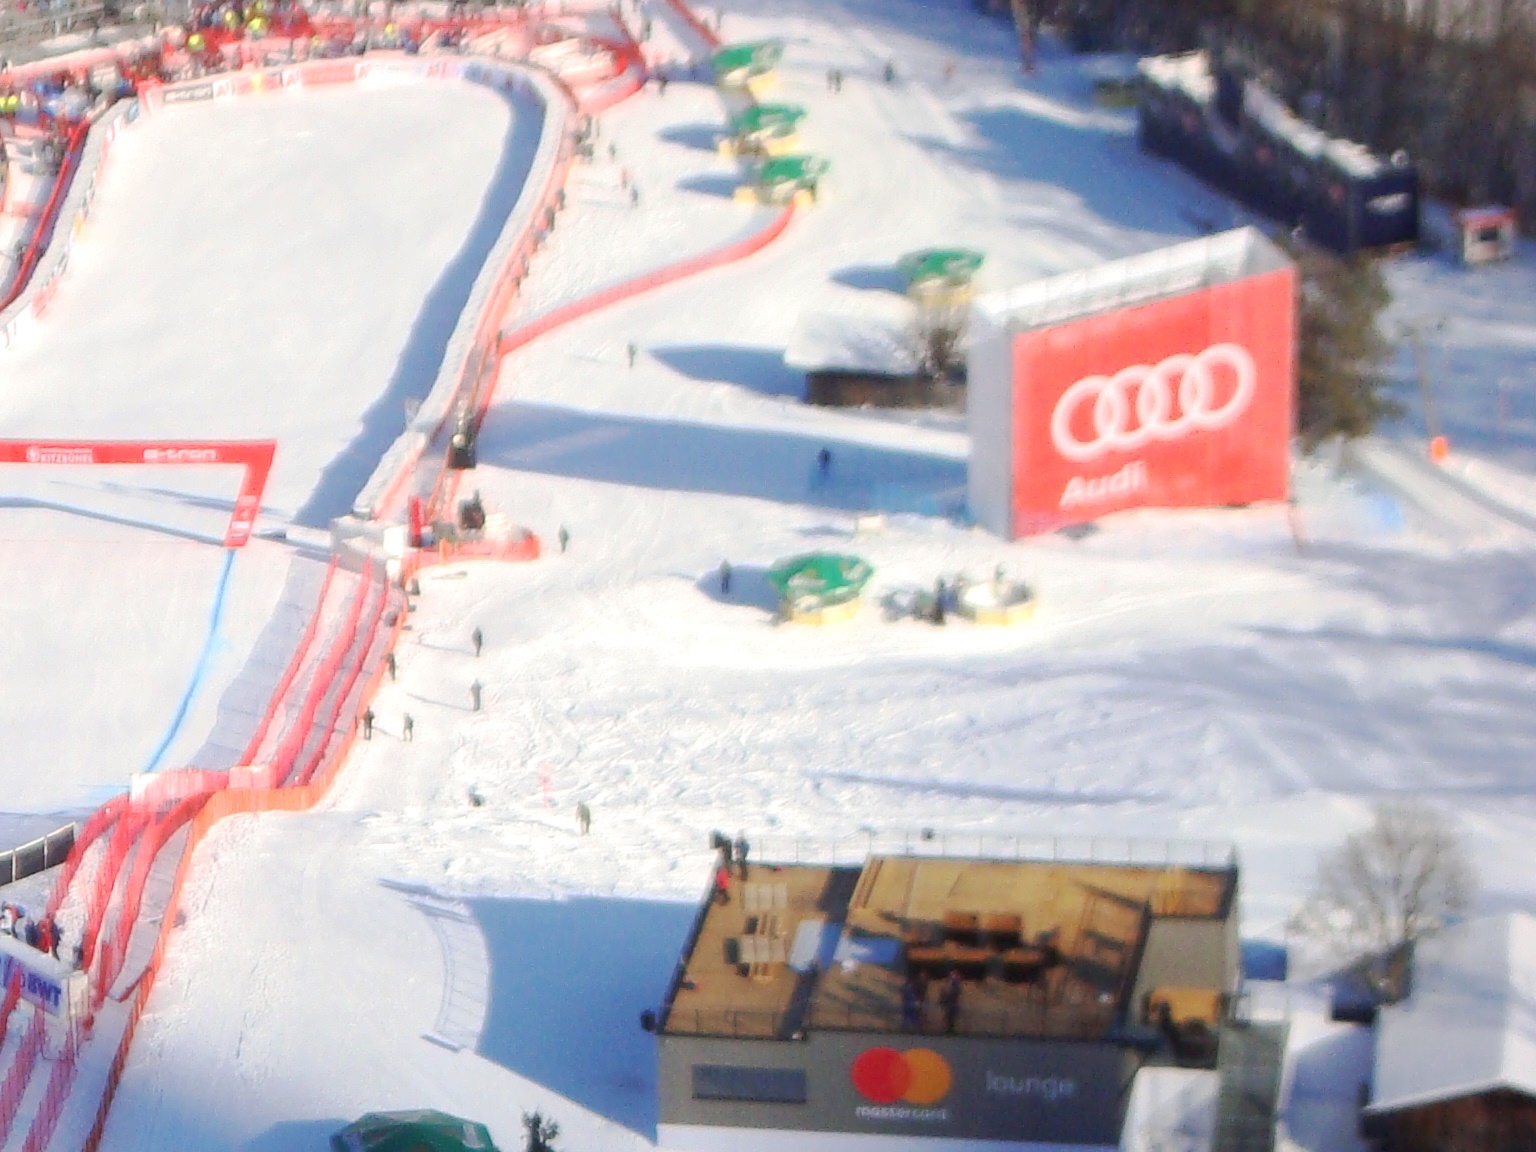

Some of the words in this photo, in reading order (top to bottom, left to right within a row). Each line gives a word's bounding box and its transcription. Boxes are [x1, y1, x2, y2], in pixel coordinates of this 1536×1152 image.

[1058, 460, 1151, 508] Audi
[27, 972, 62, 1007] BWT
[986, 1070, 1075, 1100] lounge
